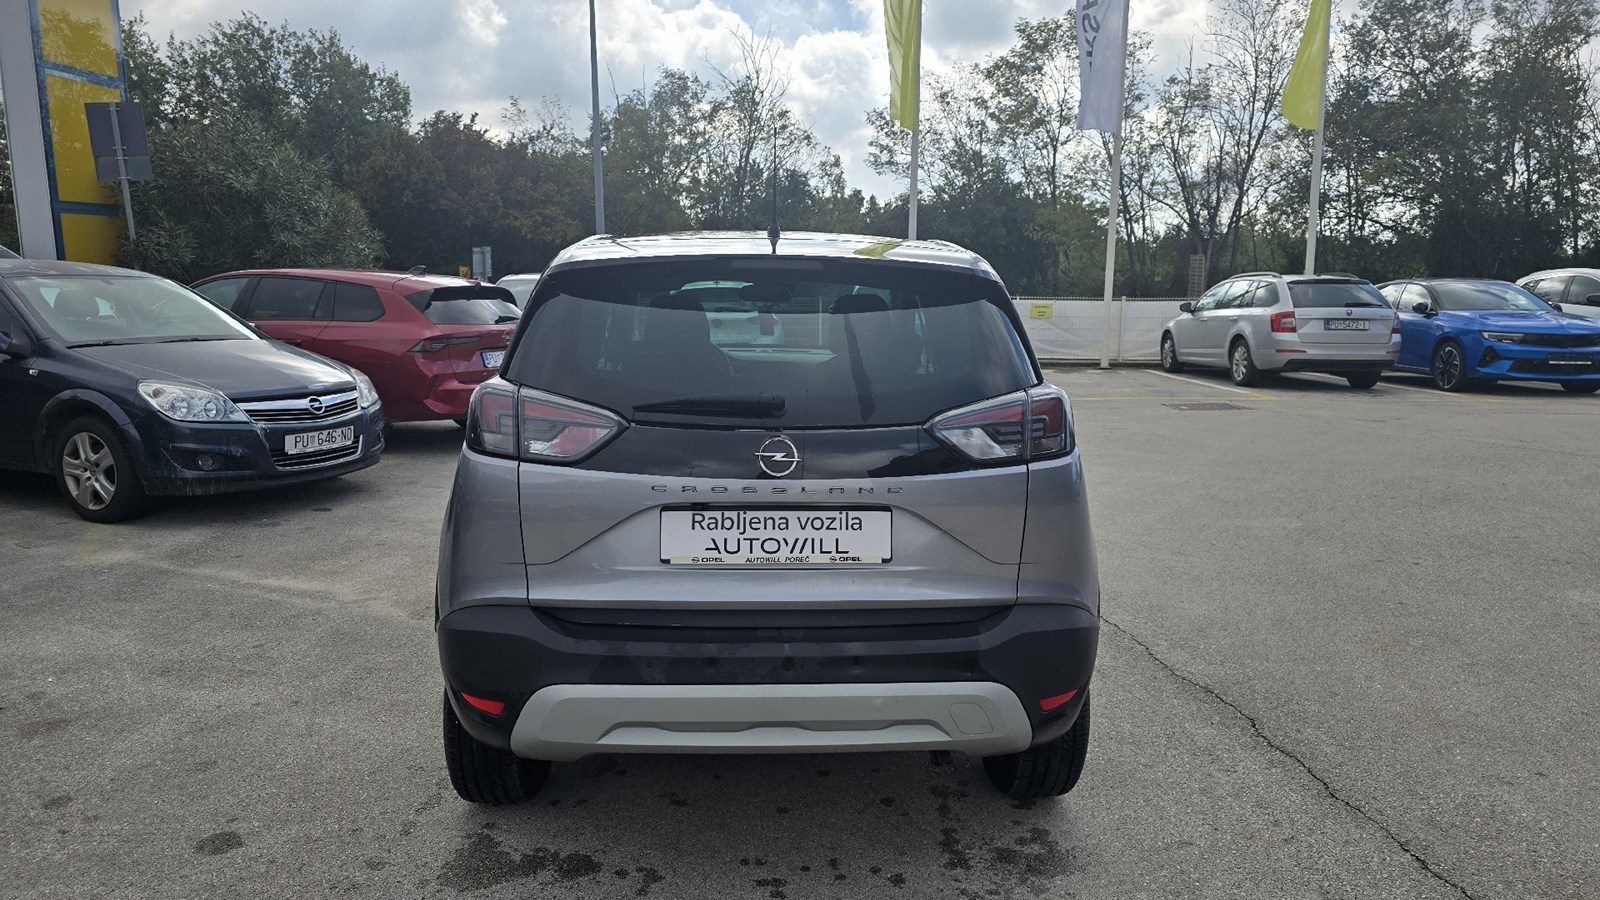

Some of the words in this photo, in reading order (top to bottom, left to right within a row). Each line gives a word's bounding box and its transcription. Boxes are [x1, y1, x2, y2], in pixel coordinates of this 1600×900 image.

[294, 434, 309, 449] PU
[651, 484, 903, 495] CROSSLAND
[691, 510, 790, 535] Rabljena
[796, 511, 863, 532] vozila
[704, 537, 850, 555] AUTOWILL
